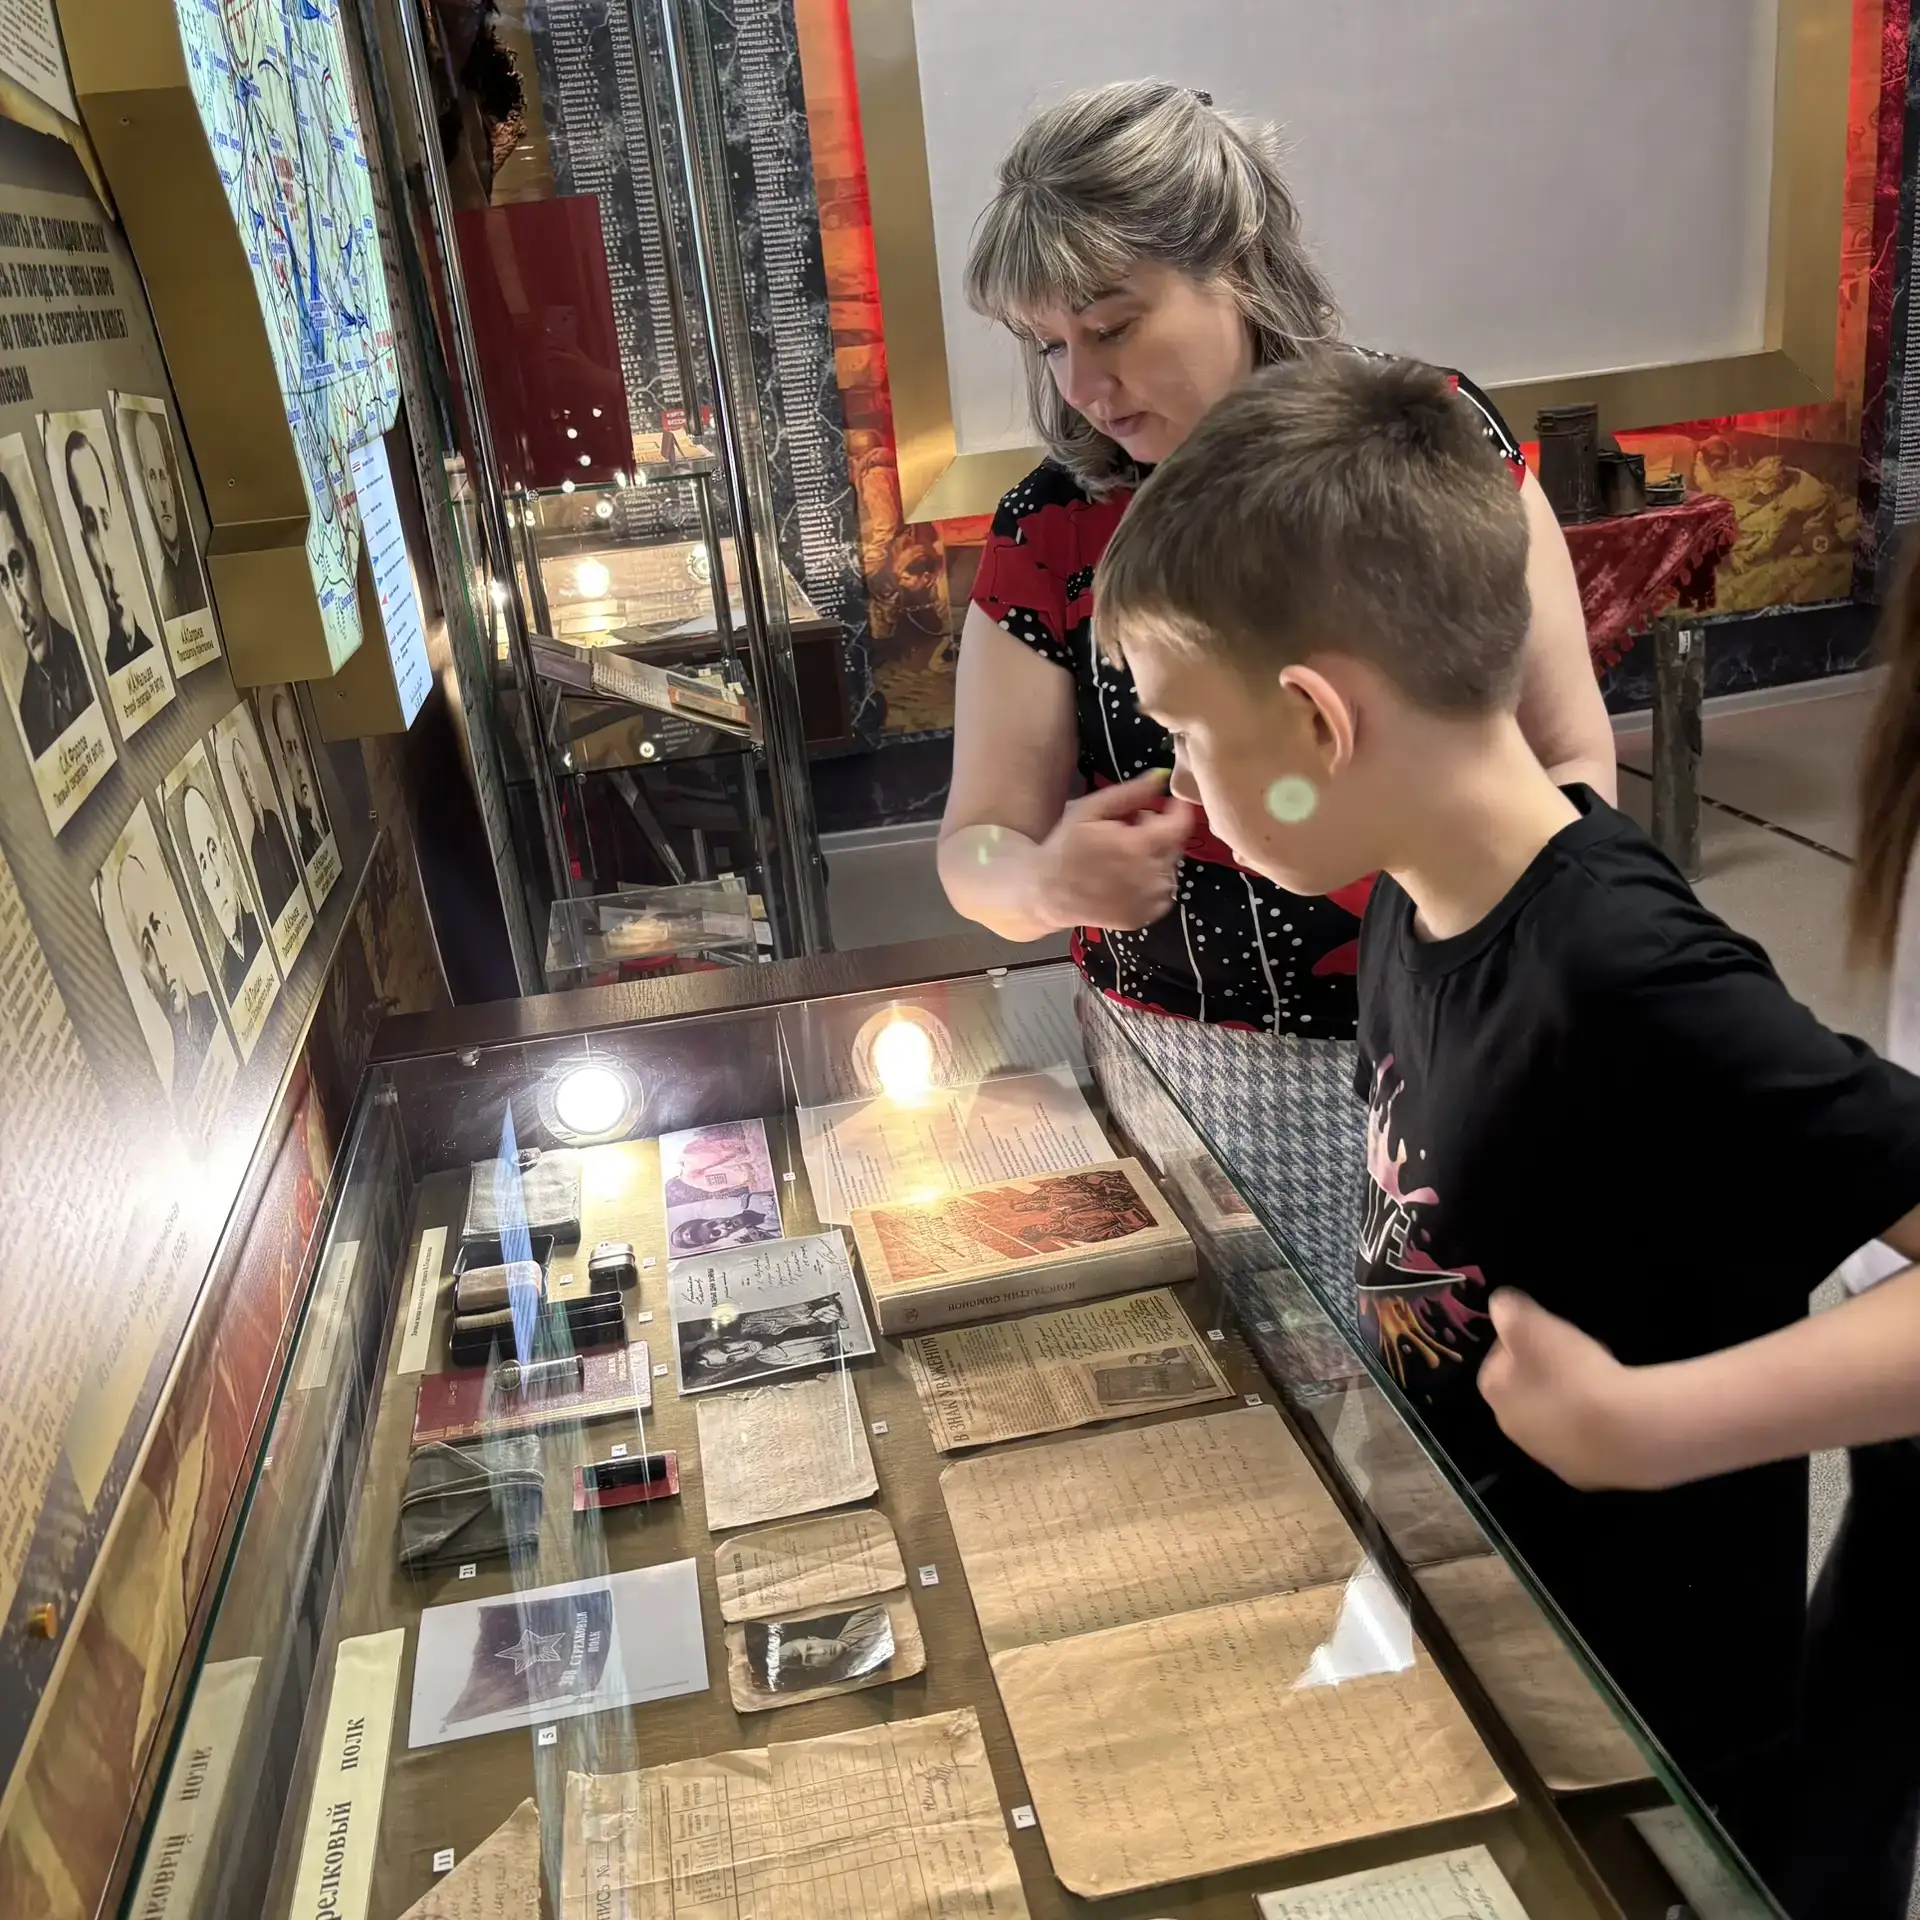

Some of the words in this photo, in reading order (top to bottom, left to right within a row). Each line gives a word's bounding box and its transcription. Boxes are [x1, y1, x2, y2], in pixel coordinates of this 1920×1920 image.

[18, 263, 53, 302] ГОРОДЕ
[49, 265, 69, 296] ВСЕ
[66, 266, 93, 296] ЧЛЕНЫ
[90, 266, 115, 296] БЮРО
[11, 313, 42, 348] ГЛАВЕ
[38, 313, 49, 346] С
[90, 311, 105, 340] РК
[1003, 1282, 1075, 1301] КОНСТАНТИН
[948, 1295, 1000, 1311] СИМОНОВ
[920, 1336, 953, 1397] УВАЖЕНИЯ
[941, 1399, 965, 1430] ЗНАК
[952, 1433, 969, 1441] В
[462, 1566, 473, 1576] 21
[923, 1568, 935, 1583] 10
[588, 1630, 602, 1652] ПОЛК
[340, 1717, 365, 1771] полк
[543, 1731, 554, 1740] 5
[1018, 1813, 1030, 1822] 7
[438, 1854, 451, 1867] 11
